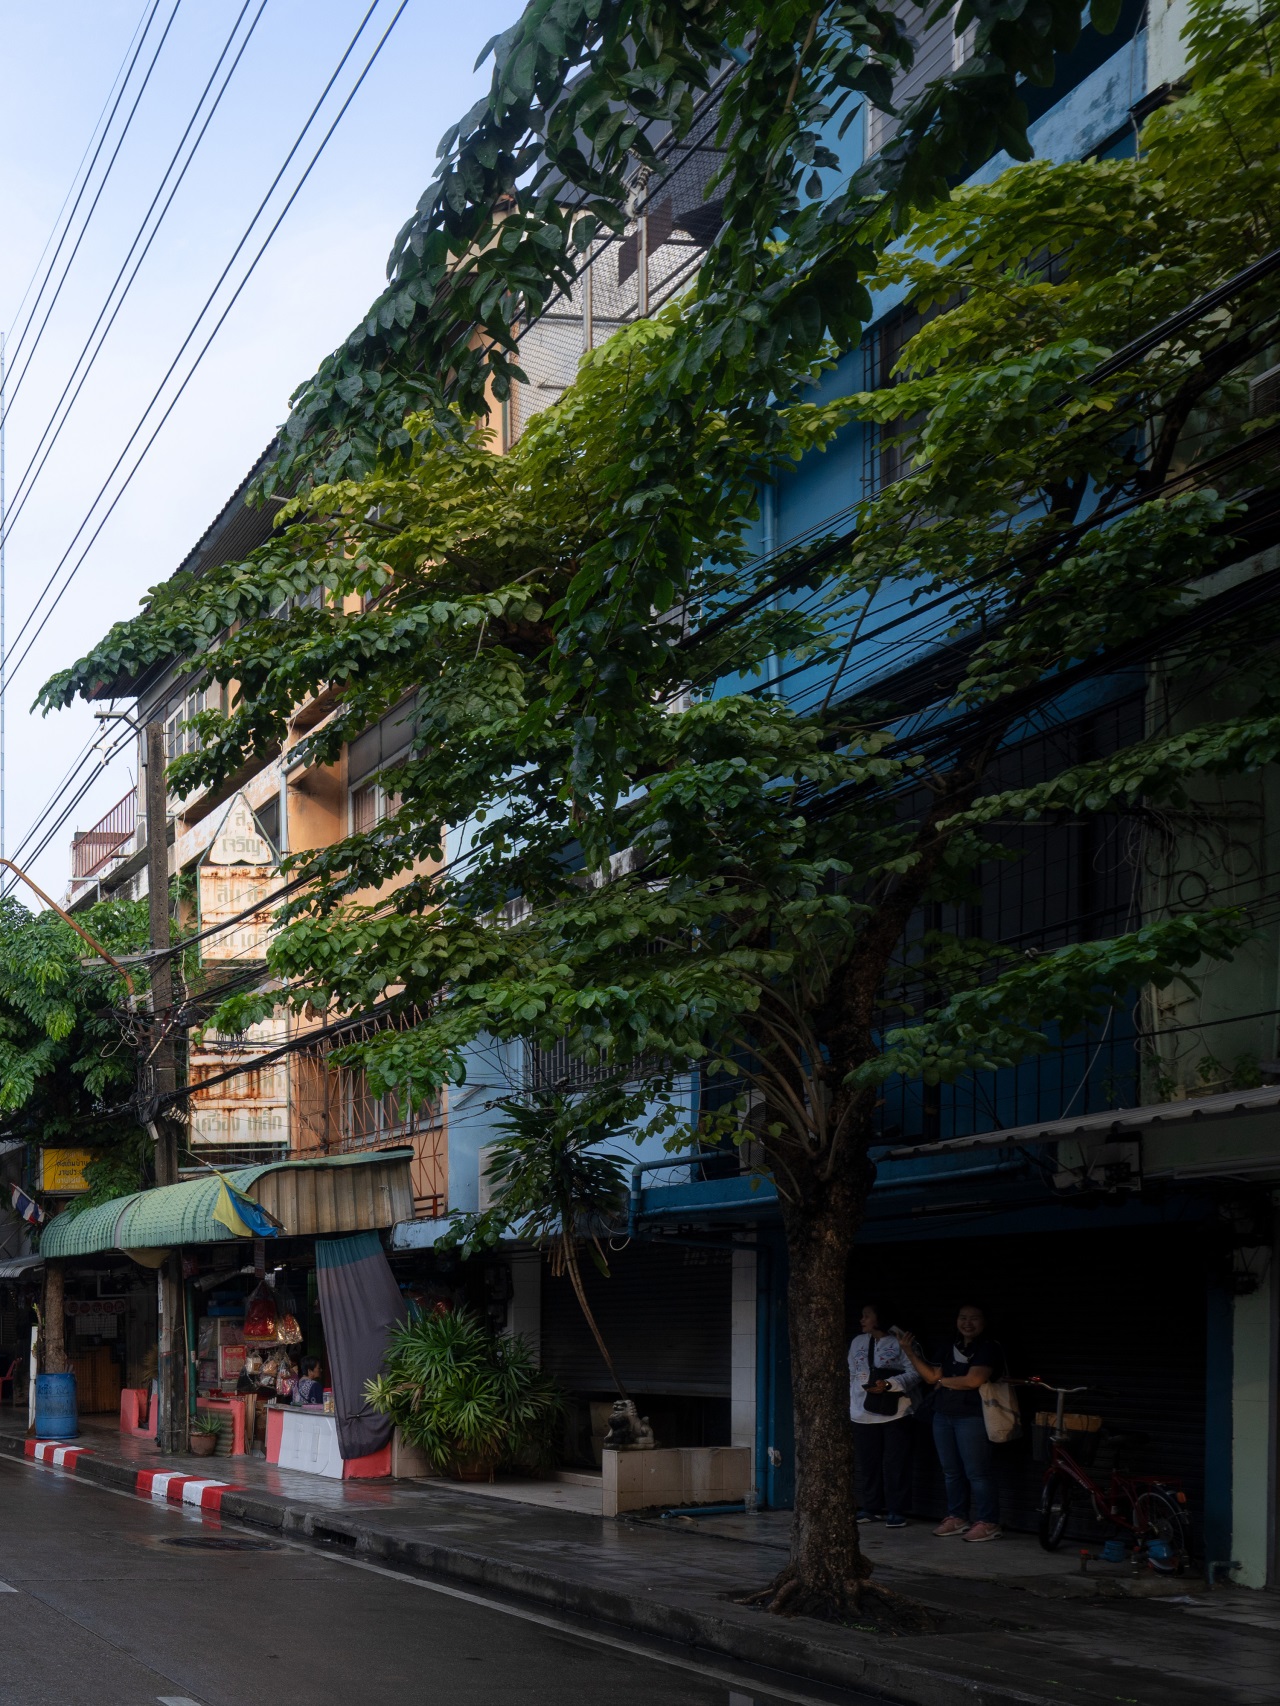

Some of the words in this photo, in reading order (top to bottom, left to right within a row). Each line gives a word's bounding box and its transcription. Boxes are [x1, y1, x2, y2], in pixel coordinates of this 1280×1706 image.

[223, 836, 261, 857] เจริญ
[195, 1111, 241, 1132] เครื่อง
[248, 1109, 282, 1131] เหล็ก
